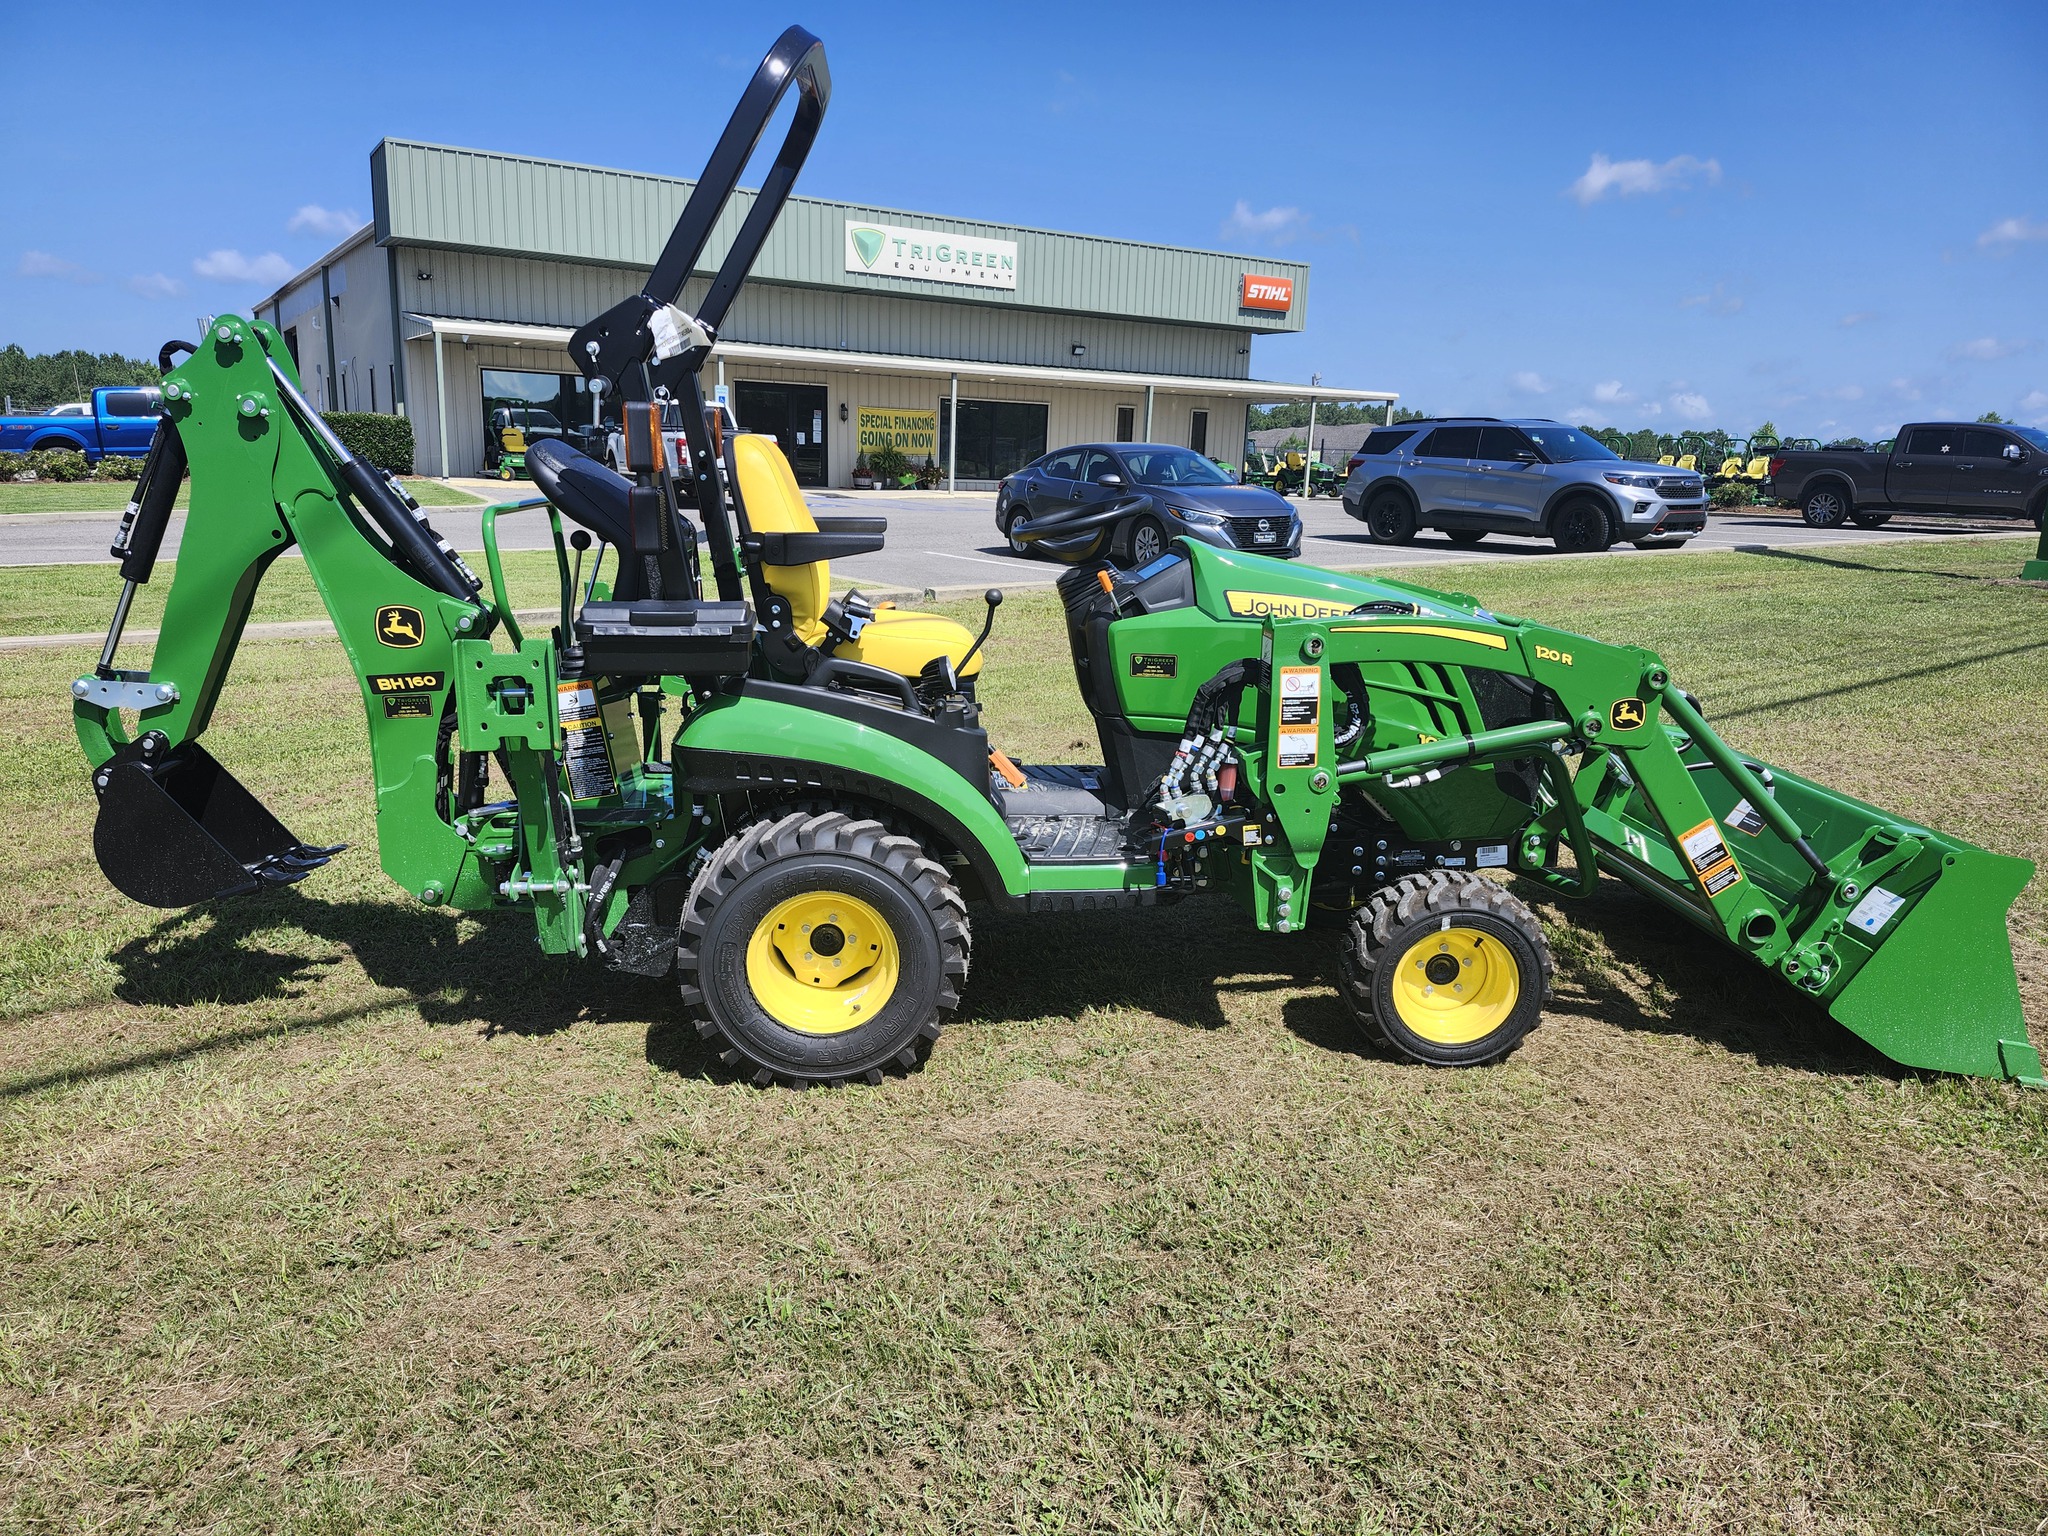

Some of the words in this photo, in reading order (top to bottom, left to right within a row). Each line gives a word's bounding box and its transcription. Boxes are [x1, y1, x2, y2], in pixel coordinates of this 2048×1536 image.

[892, 237, 1014, 271] TRIGREEN
[894, 261, 1013, 282] EQUIPMENT
[1247, 284, 1289, 301] STIHL
[860, 413, 893, 430] SPECIAL
[894, 416, 935, 431] FINANCING
[860, 430, 893, 447] GOING
[895, 432, 909, 447] ON
[911, 433, 934, 448] NOW
[1244, 598, 1297, 618] JOHN
[1534, 644, 1561, 662] 120
[1561, 652, 1573, 666] R
[376, 677, 406, 691] BH
[405, 675, 437, 689] 160
[557, 682, 589, 693] WARNING
[567, 720, 597, 730] CAUTION
[817, 995, 918, 1062] CARLSTAR
